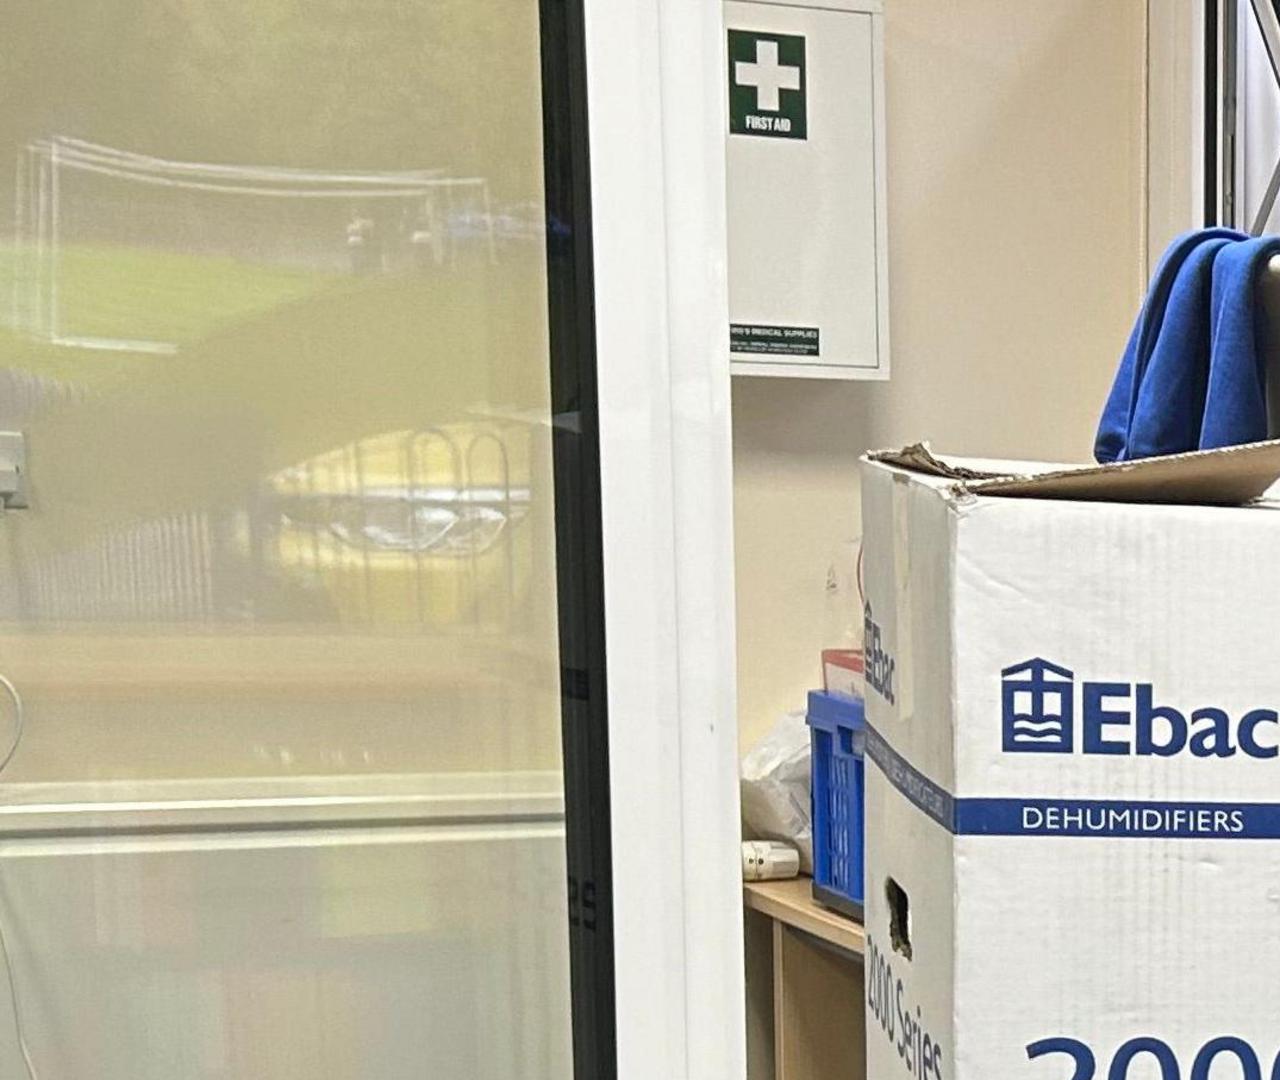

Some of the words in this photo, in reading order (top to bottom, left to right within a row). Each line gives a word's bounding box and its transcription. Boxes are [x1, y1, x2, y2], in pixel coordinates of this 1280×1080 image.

[746, 115, 774, 131] FIRST
[774, 117, 791, 132] AID
[1082, 682, 1279, 758] Ebac
[1023, 807, 1244, 832] DEHUMIDIFIERS
[867, 933, 895, 1042] 2000
